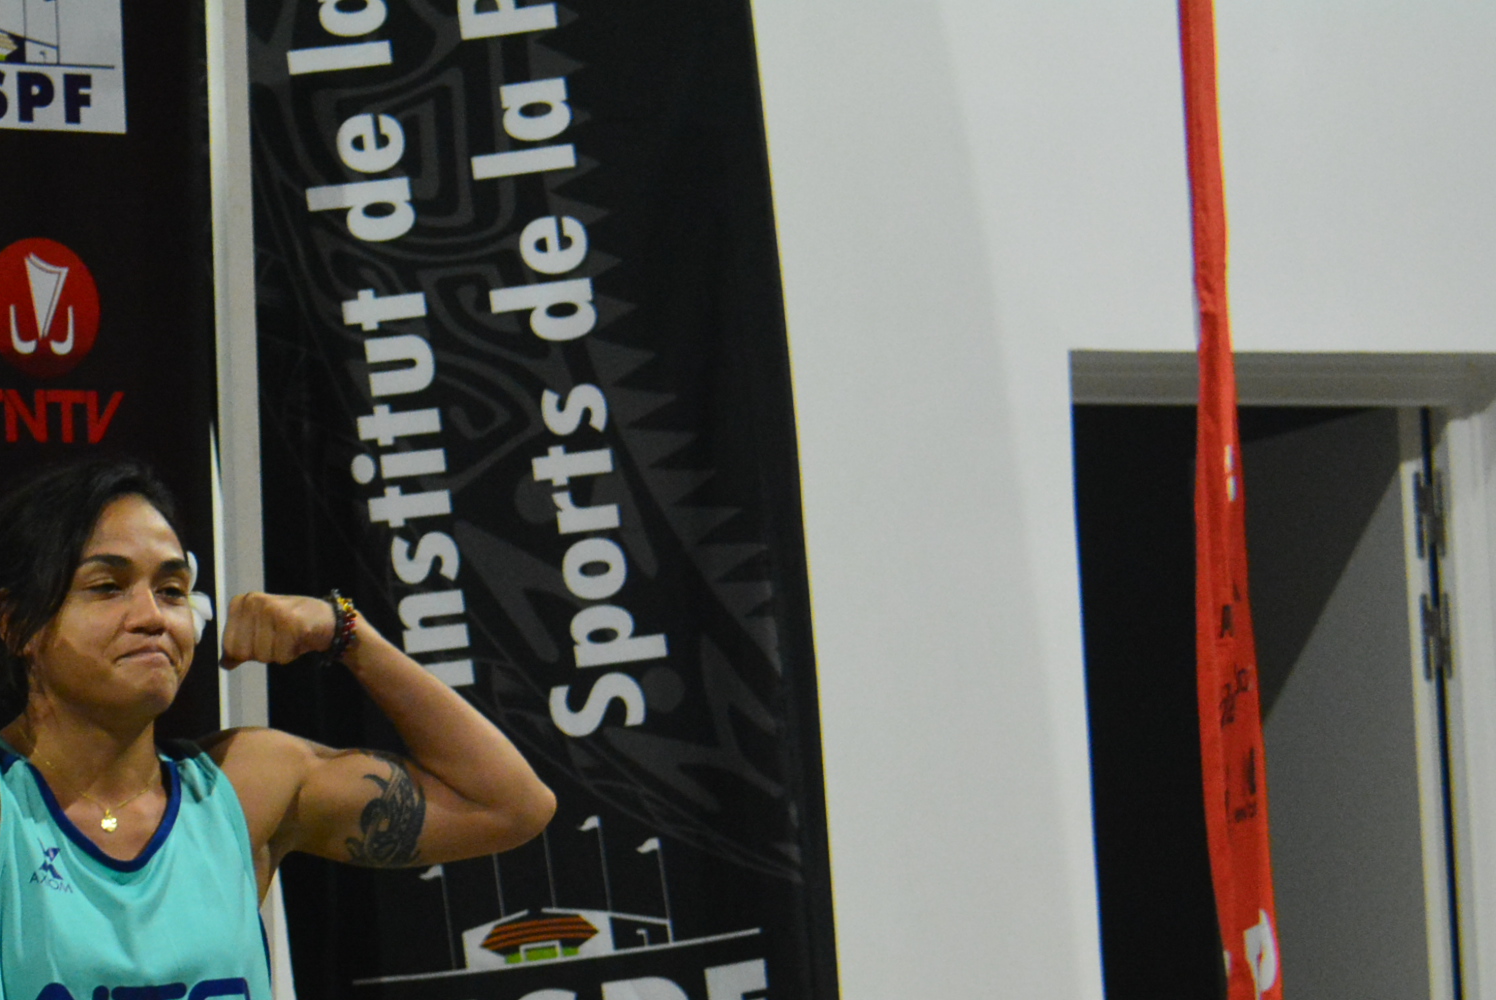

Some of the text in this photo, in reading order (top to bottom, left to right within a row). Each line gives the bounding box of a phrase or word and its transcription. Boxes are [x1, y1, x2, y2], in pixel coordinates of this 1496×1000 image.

[306, 112, 415, 242] de
[471, 77, 577, 180] la
[489, 214, 597, 342] de
[532, 383, 668, 738] Sports
